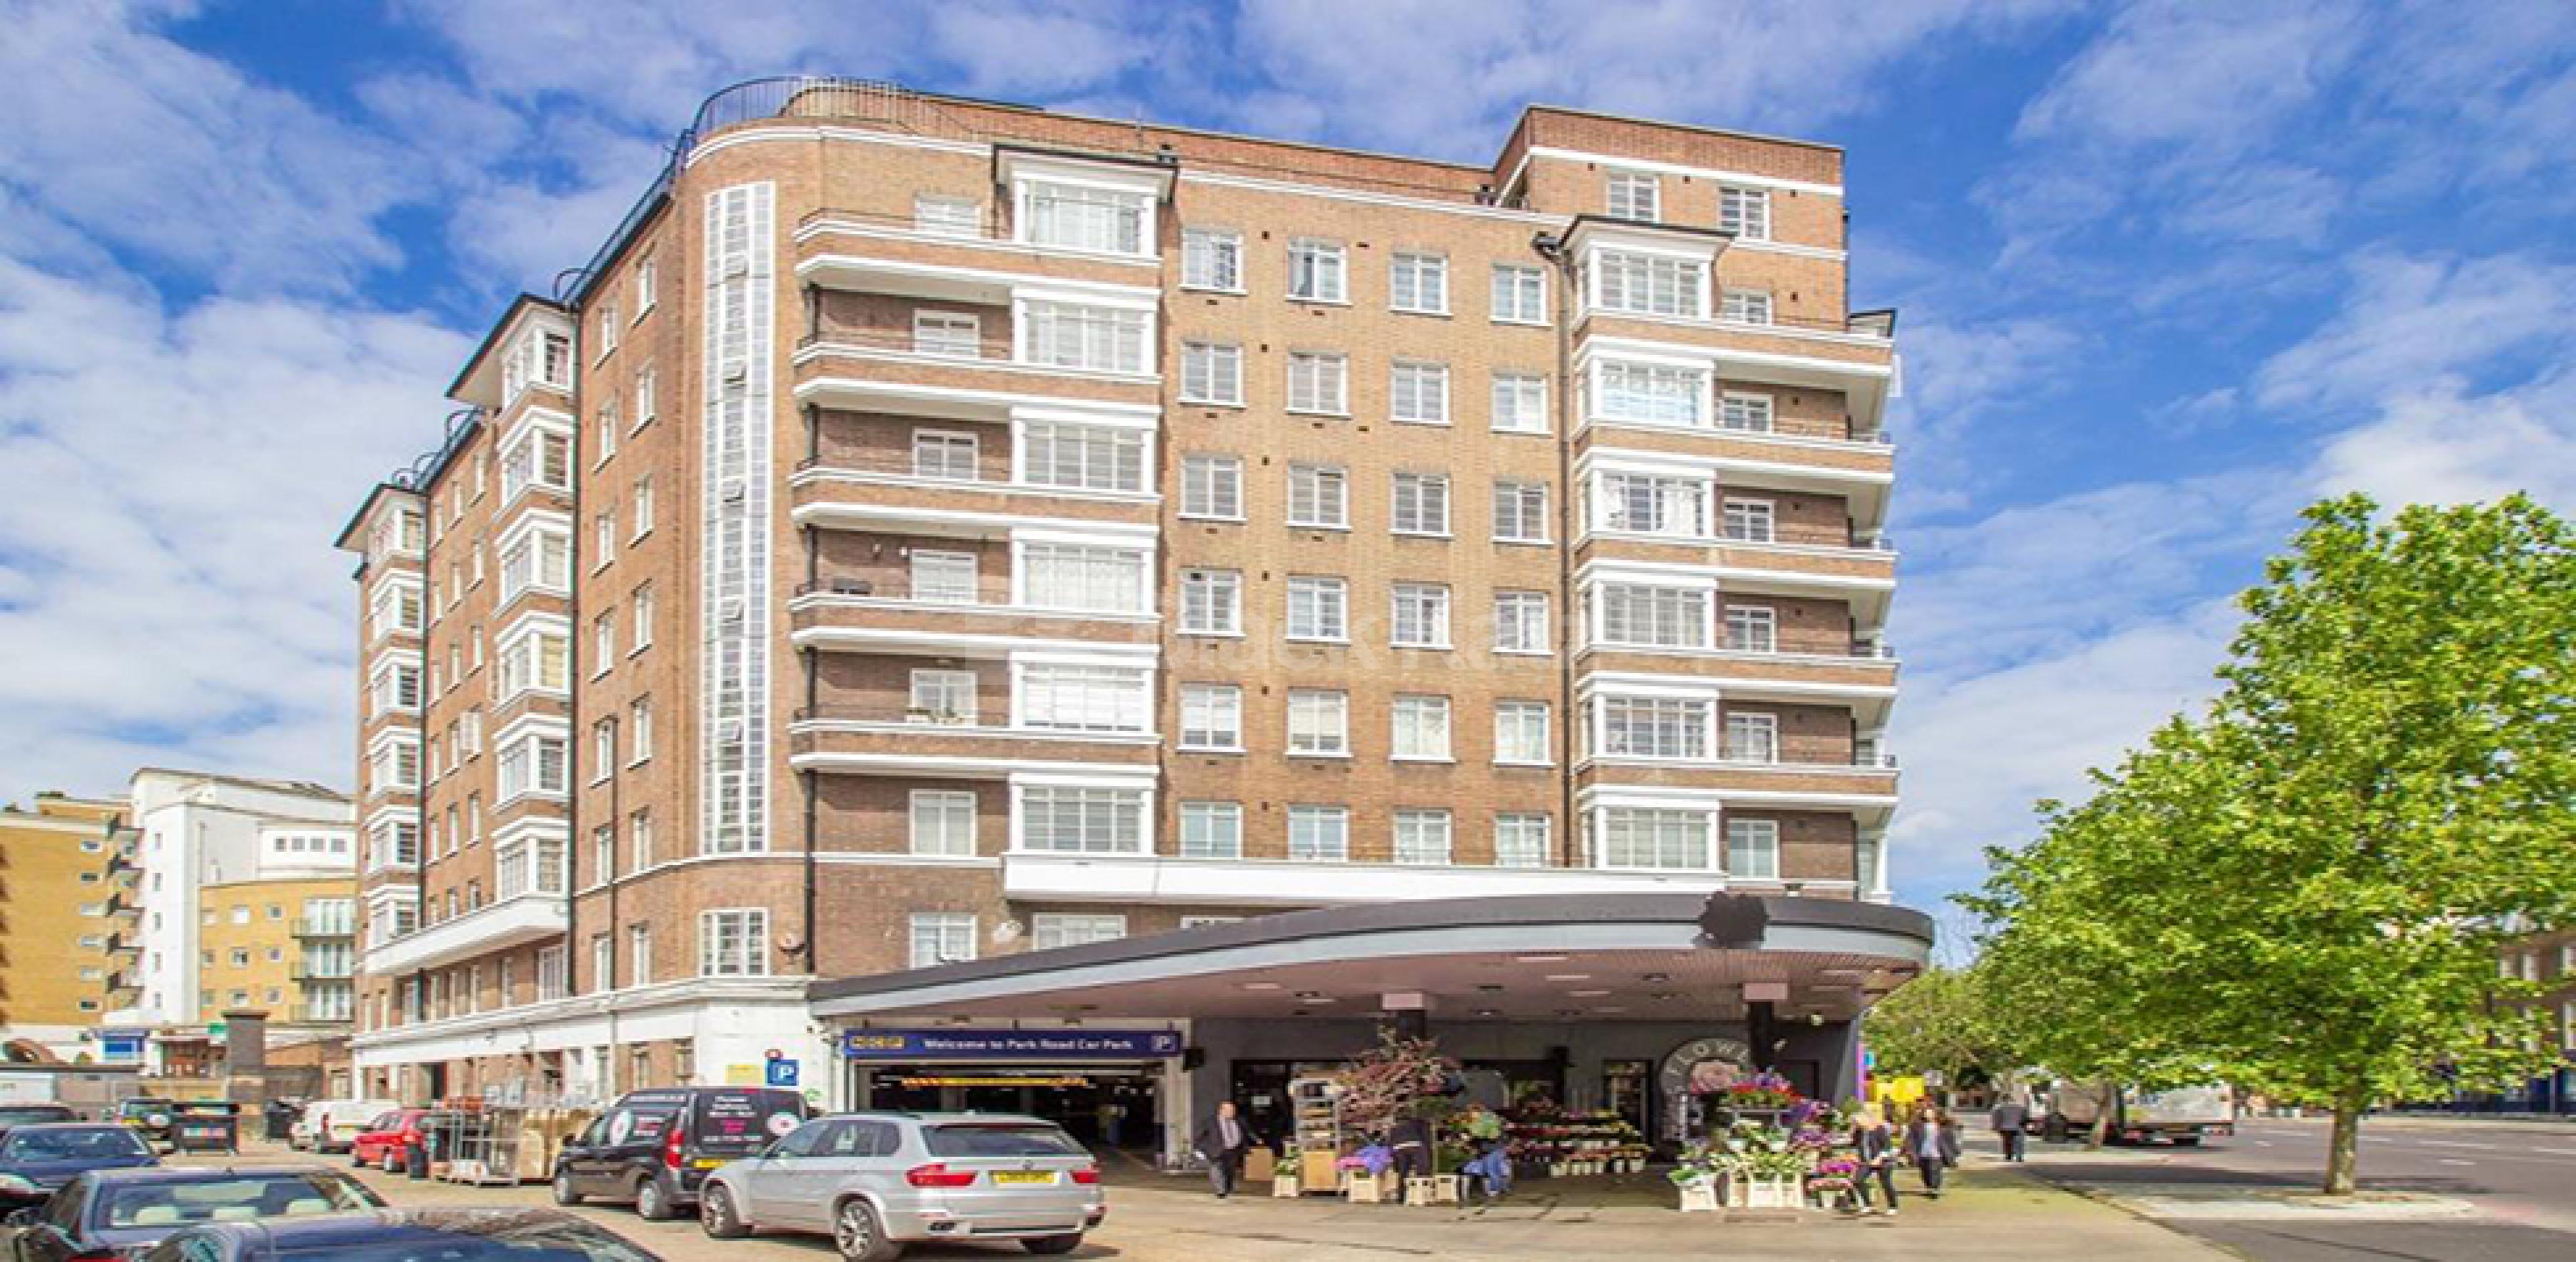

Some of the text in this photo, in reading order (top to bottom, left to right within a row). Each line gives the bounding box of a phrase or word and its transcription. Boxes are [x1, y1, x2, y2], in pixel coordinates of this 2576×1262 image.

[924, 1038, 1134, 1050] Welcome to Park Road Car Park
